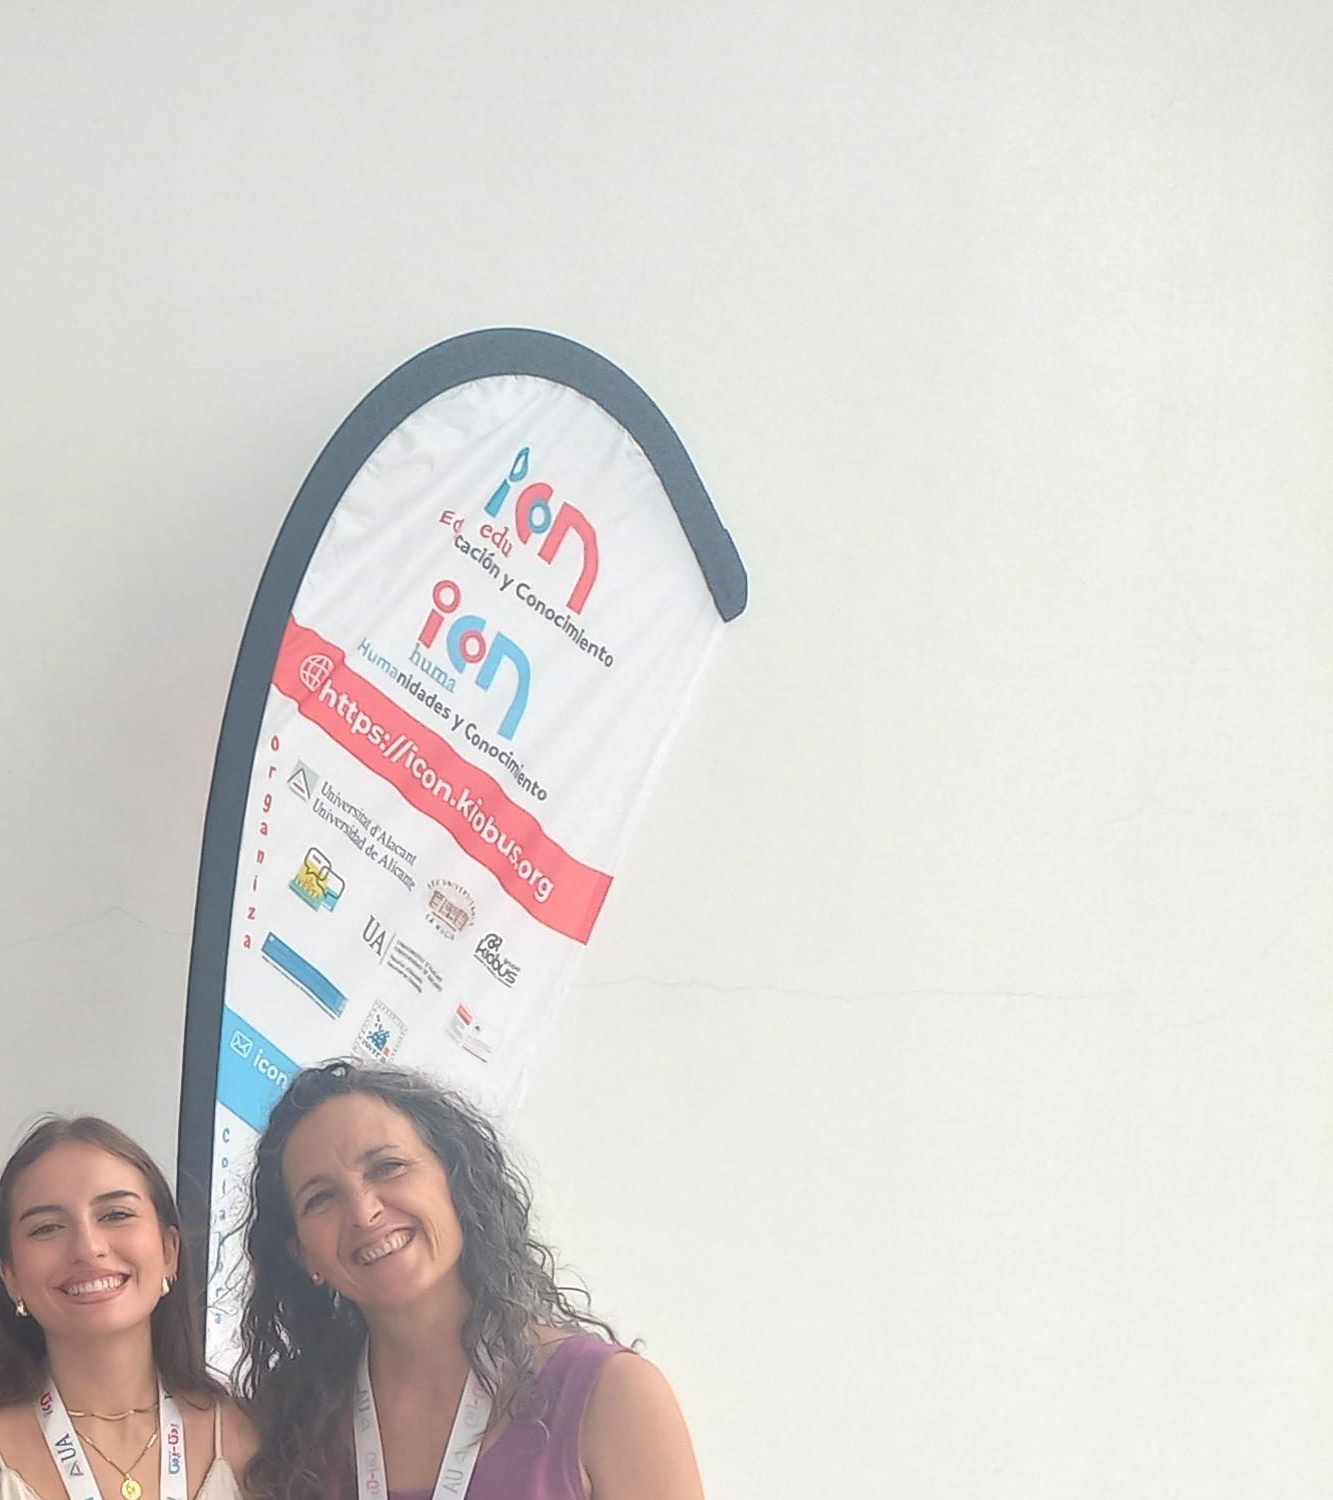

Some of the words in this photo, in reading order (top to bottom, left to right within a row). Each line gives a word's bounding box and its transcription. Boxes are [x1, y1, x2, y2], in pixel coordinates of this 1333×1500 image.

[480, 523, 513, 558] edu
[515, 583, 614, 668] Conocimiento
[408, 643, 457, 694] huma
[357, 637, 454, 722] Humanidades
[464, 723, 549, 803] Conocimiento
[317, 681, 555, 902] https://icon.kiobus.org
[320, 782, 370, 834] Universitat
[311, 800, 366, 850] Universidad
[364, 844, 379, 862] de
[363, 915, 384, 957] UA
[57, 1432, 78, 1463] UA
